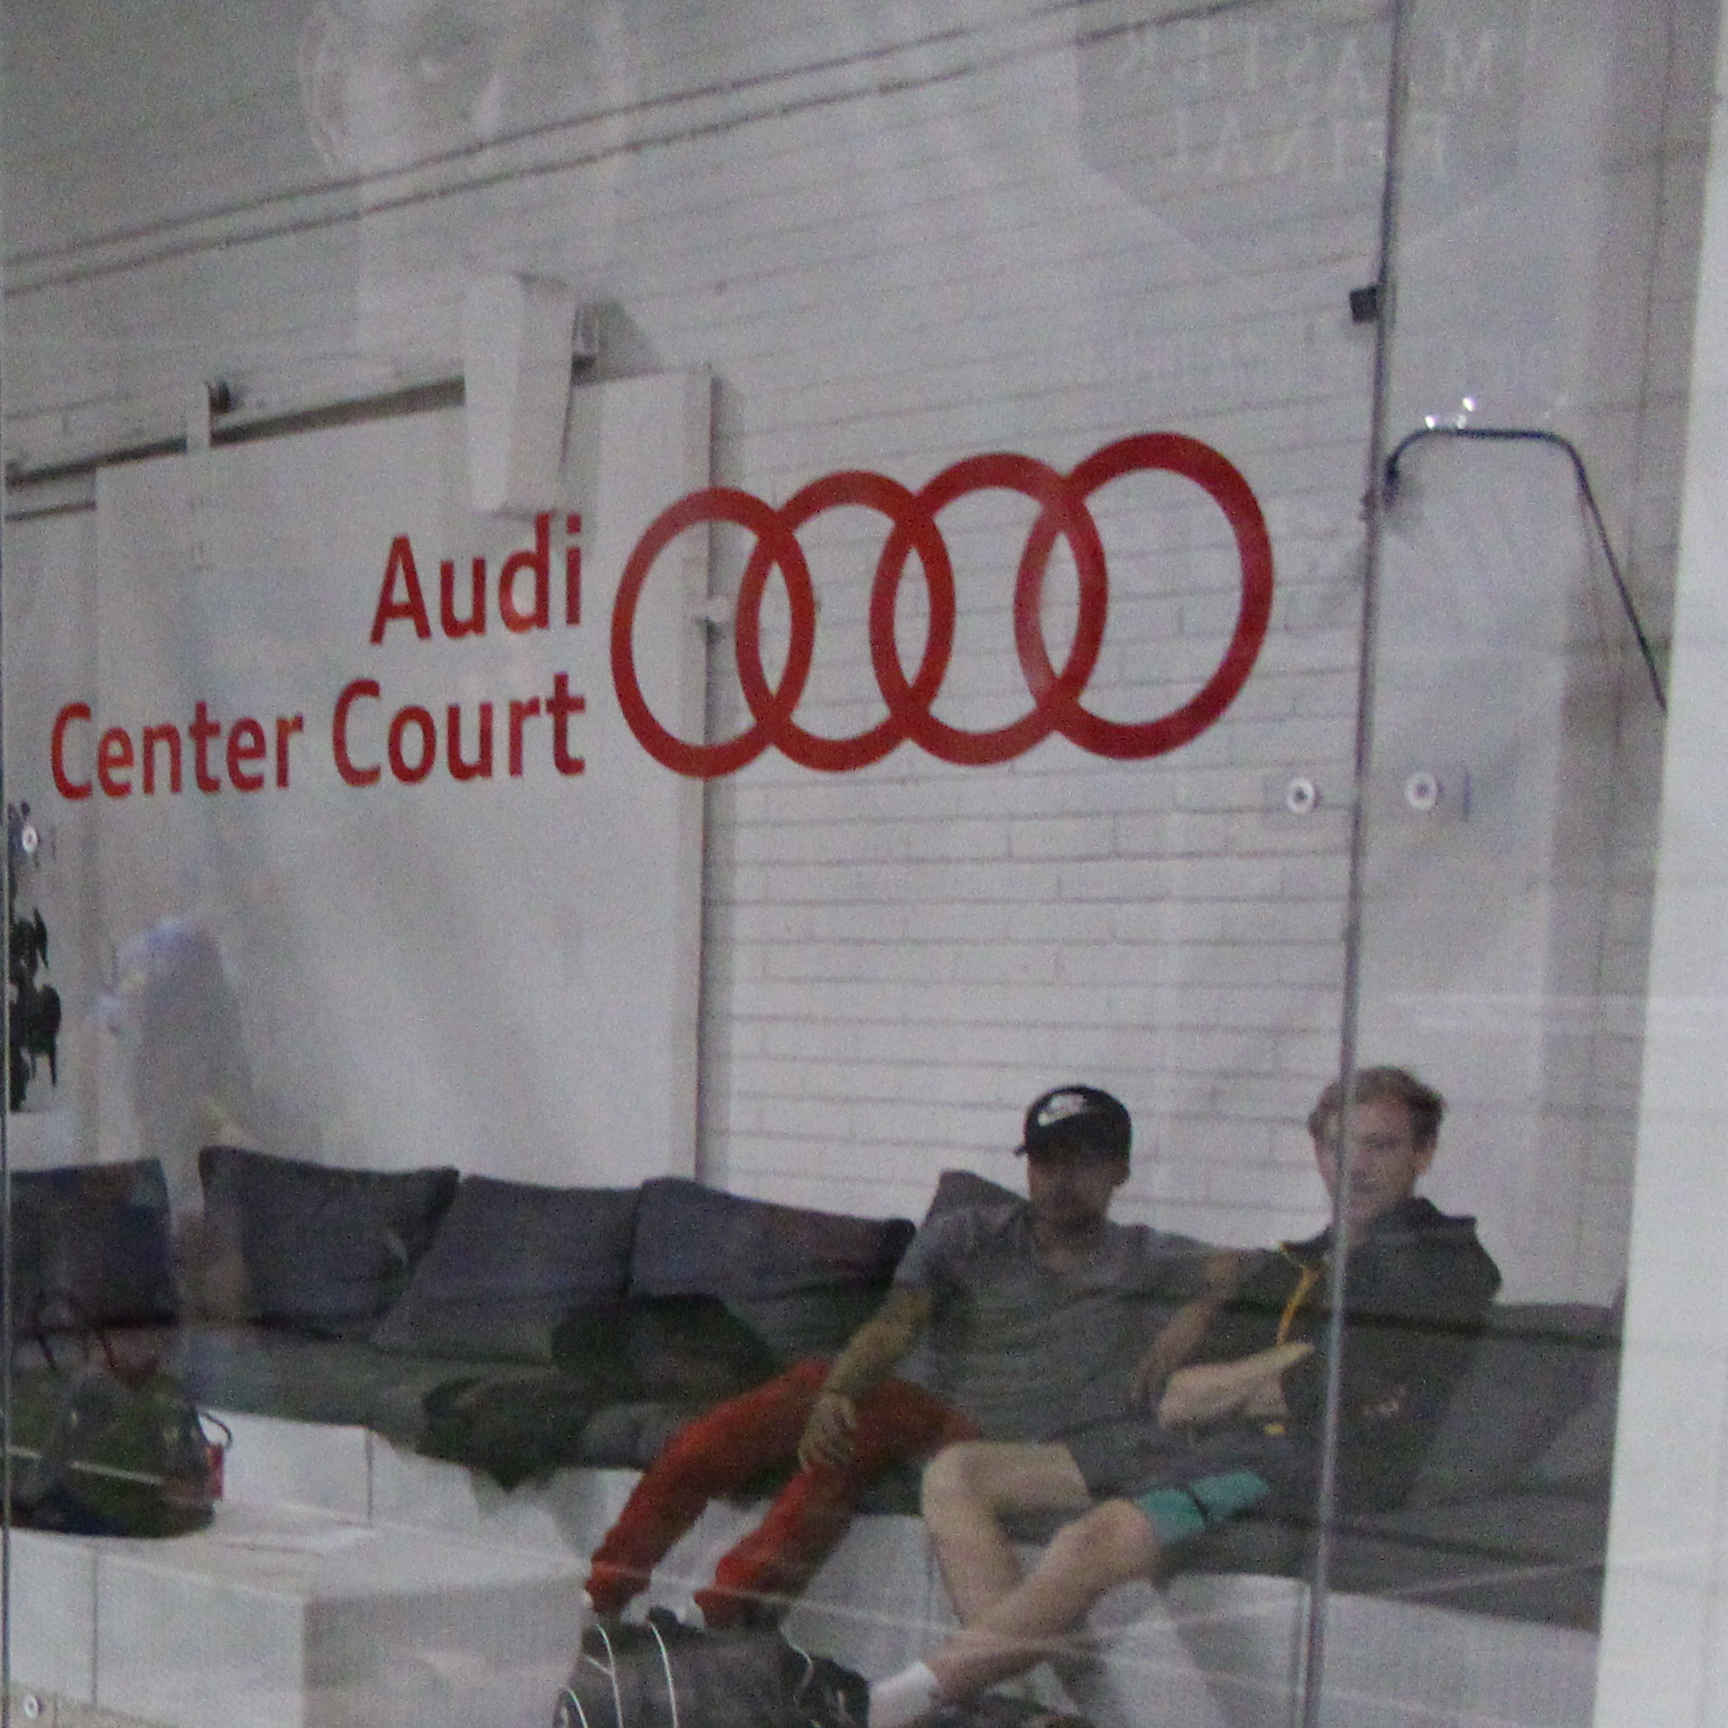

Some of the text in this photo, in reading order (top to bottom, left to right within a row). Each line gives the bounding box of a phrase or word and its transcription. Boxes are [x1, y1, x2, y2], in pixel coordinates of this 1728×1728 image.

[368, 512, 583, 645] Audi
[50, 671, 587, 800] Center Court
